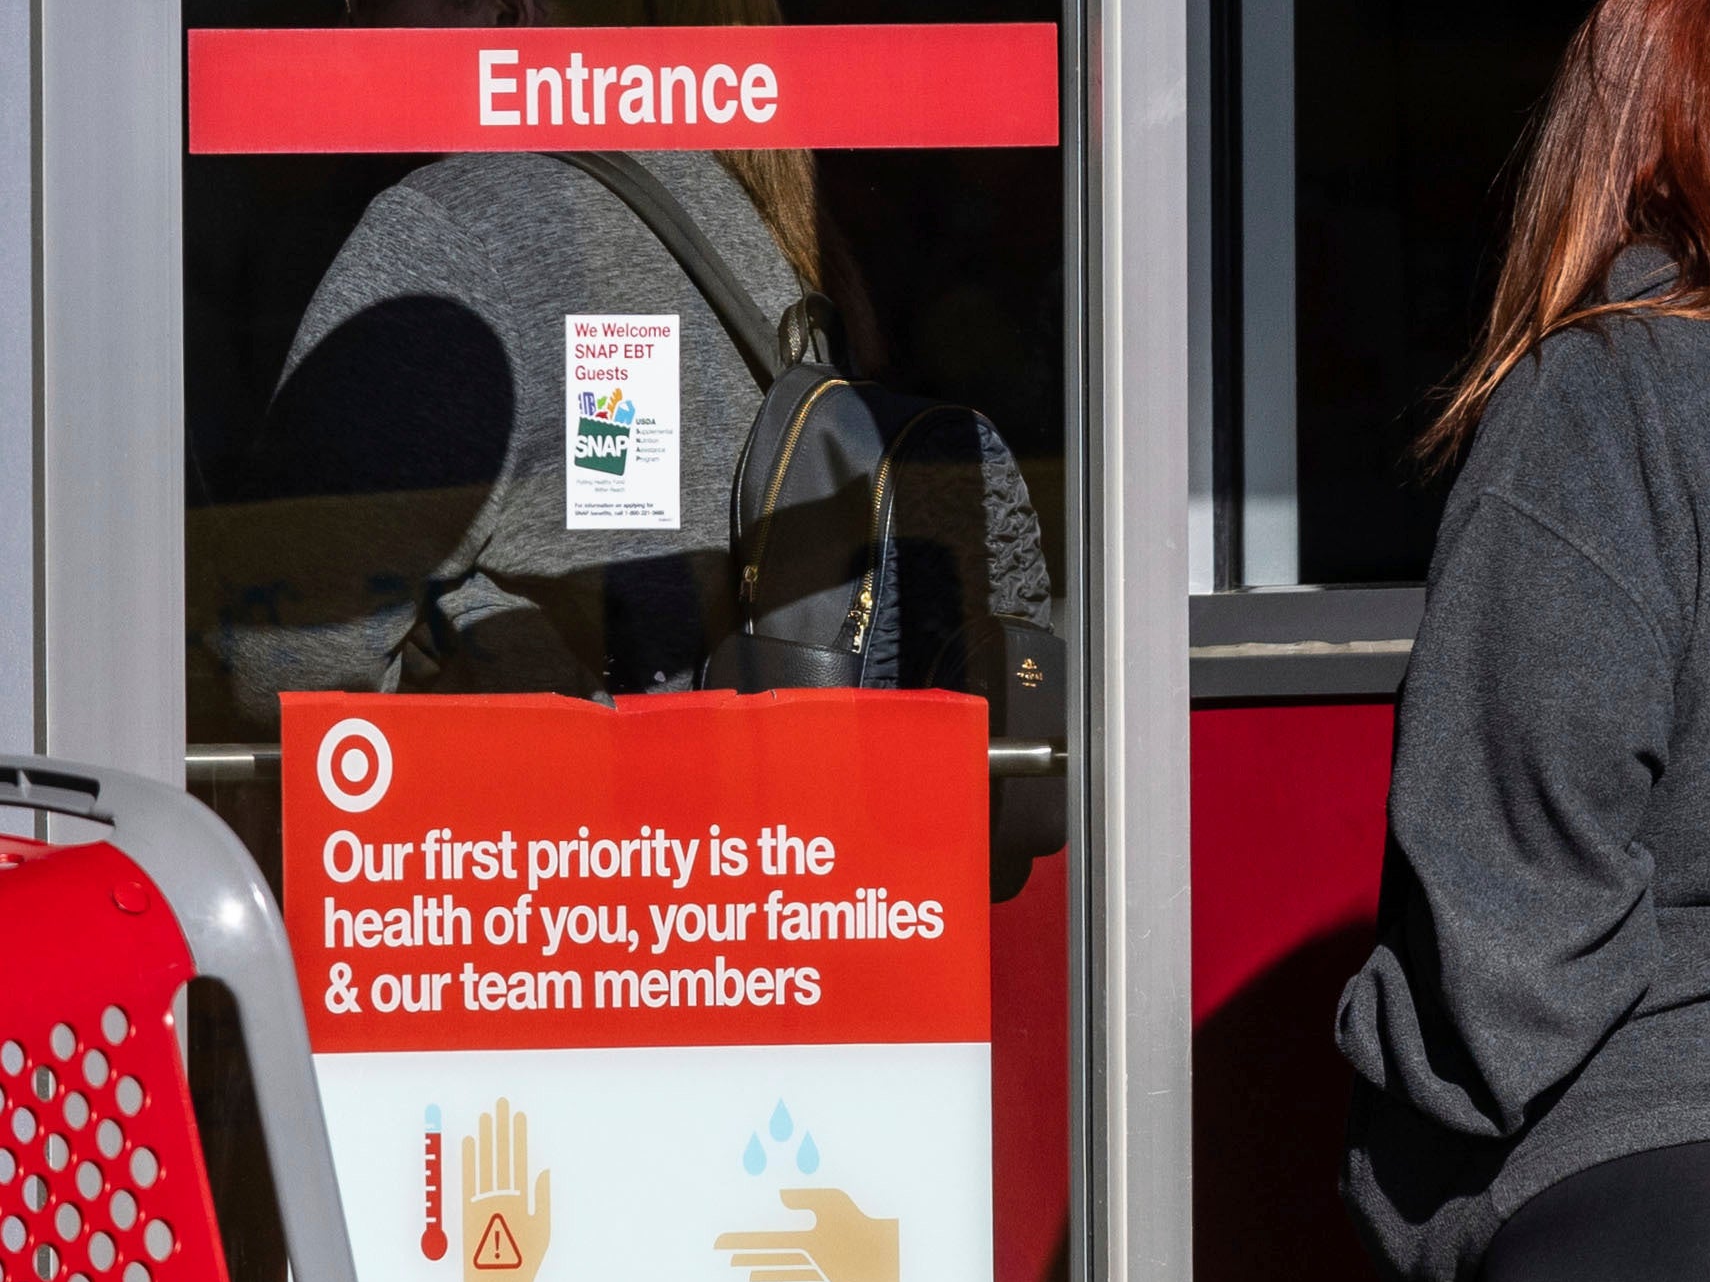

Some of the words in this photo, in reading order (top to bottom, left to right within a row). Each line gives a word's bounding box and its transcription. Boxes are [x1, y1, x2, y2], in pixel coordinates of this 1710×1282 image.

[478, 49, 778, 126] Entrance
[575, 323, 597, 338] We
[602, 323, 671, 338] Welcome
[575, 344, 618, 359] SNAP
[624, 344, 654, 359] EBT
[575, 366, 629, 381] Guests
[575, 435, 628, 458] SNAP
[323, 829, 412, 883] Our
[421, 828, 517, 880] first
[528, 826, 700, 890] priority
[709, 824, 749, 876] is
[757, 825, 835, 875] the
[324, 895, 473, 948] health
[483, 894, 535, 945] of
[541, 900, 639, 956] you,
[650, 899, 757, 953] your
[763, 888, 945, 942] families
[325, 963, 362, 1013] &
[370, 970, 454, 1013] our
[459, 962, 582, 1012] team
[594, 956, 822, 1010] members
